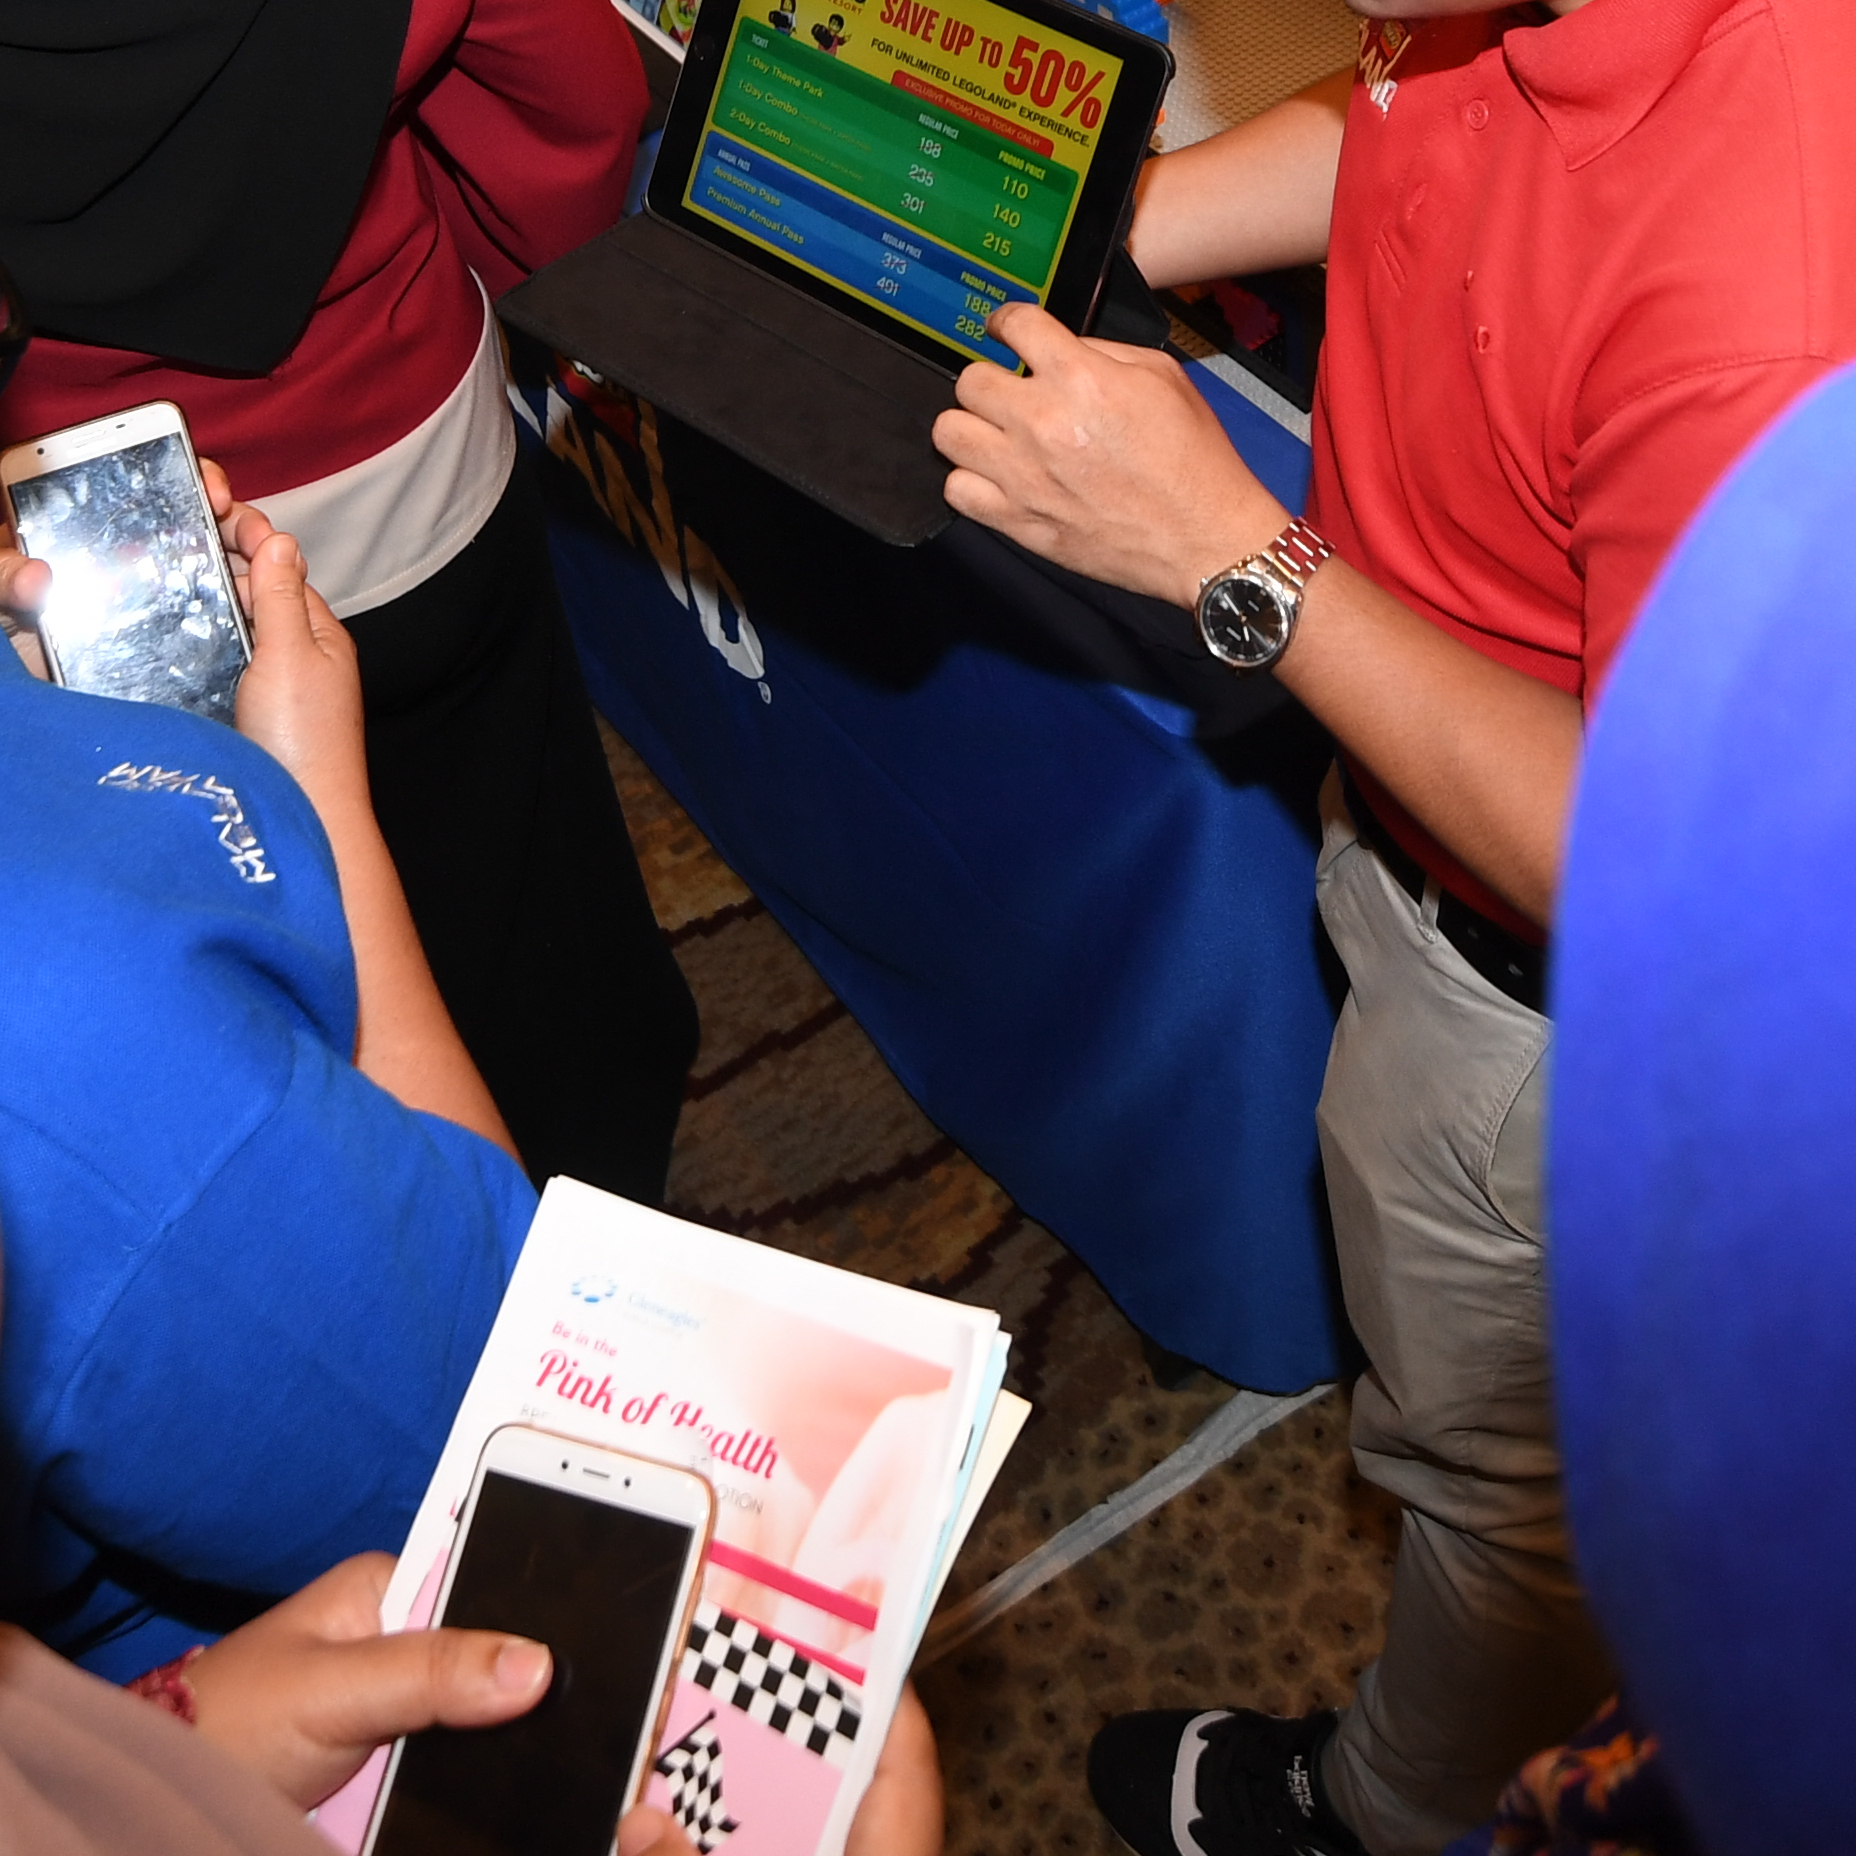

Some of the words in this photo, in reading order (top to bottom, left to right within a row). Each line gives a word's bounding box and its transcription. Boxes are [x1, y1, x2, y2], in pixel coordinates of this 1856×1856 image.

[870, 37, 894, 56] FOR
[894, 48, 951, 82] UNLIMITED
[771, 64, 802, 89] Theme
[802, 80, 825, 99] Park
[939, 17, 976, 56] UP
[977, 35, 1004, 70] TO
[1002, 34, 1107, 130] 50%
[764, 92, 799, 117] Combo
[757, 120, 792, 146] Combo
[712, 165, 758, 195] Awesome
[758, 186, 782, 207] Pass
[907, 163, 935, 188] 235
[1002, 174, 1030, 200] 110
[706, 186, 748, 215] Premium
[748, 208, 782, 232] Annual
[781, 224, 805, 245] Pass
[900, 191, 927, 215] 301
[992, 202, 1022, 229] 140
[982, 231, 1012, 258] 215
[963, 292, 992, 318] 188
[954, 314, 986, 342] 282
[551, 1320, 573, 1340] Be
[574, 1328, 590, 1347] in
[593, 1337, 619, 1358] the
[535, 1347, 619, 1416] Pink
[620, 1391, 670, 1426] of
[669, 1400, 780, 1480] Health
